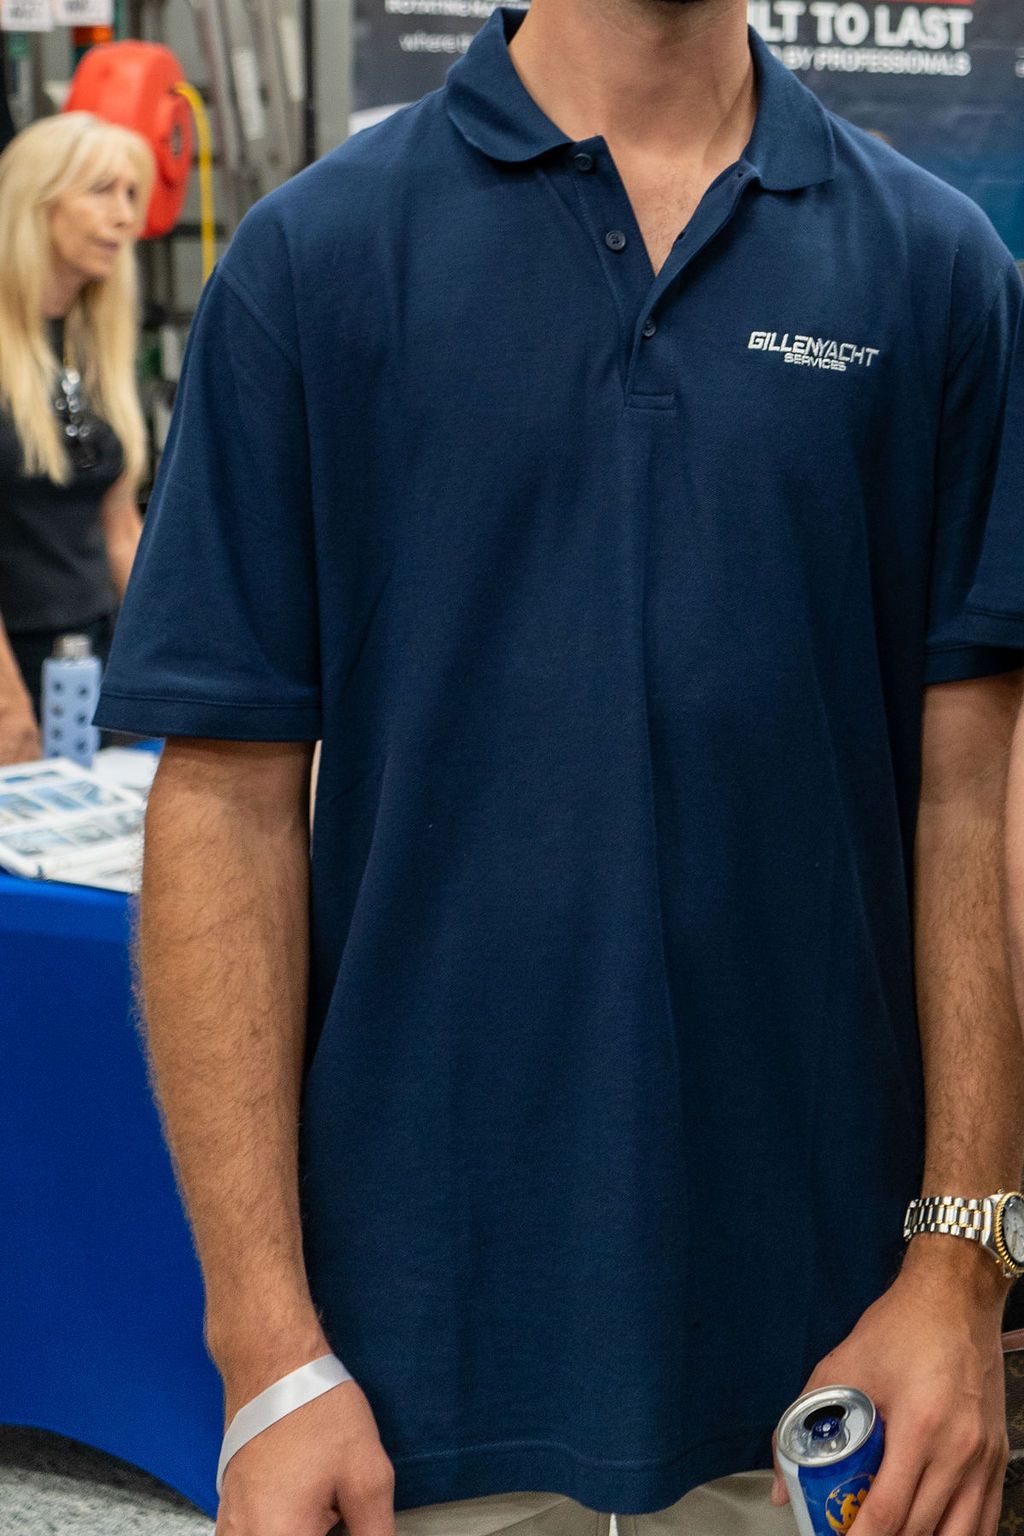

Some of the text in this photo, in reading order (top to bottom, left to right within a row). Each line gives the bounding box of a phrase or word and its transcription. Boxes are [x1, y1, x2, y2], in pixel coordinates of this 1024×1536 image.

[809, 1, 870, 46] TO
[874, 4, 973, 50] LAST
[814, 46, 972, 77] PROFESSIONALS
[783, 352, 847, 372] SERVICES
